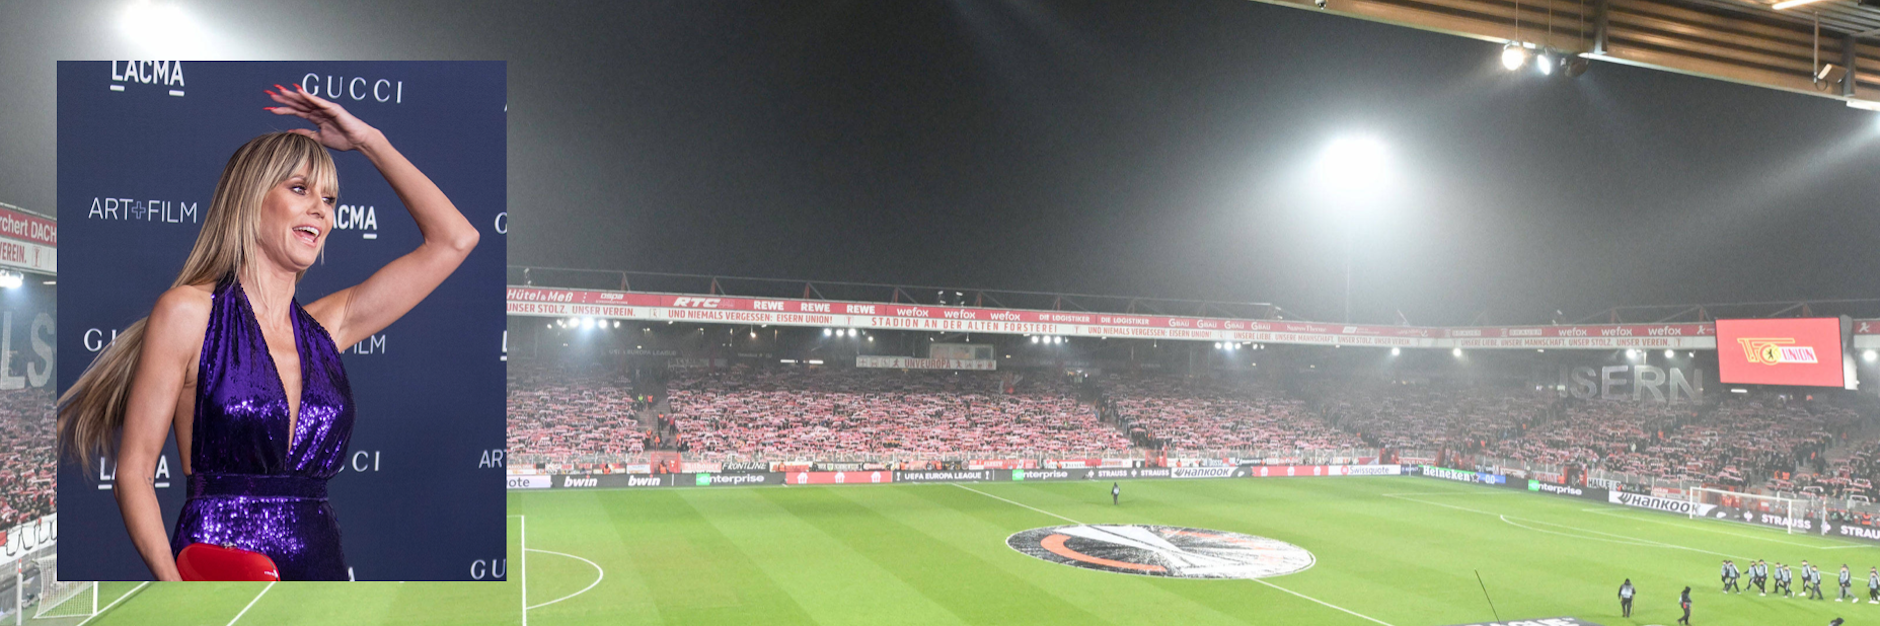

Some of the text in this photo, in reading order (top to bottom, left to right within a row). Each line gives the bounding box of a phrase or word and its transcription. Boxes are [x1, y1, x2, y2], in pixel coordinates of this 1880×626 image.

[111, 61, 185, 86] LACMA
[302, 73, 402, 103] GUCCI
[673, 297, 721, 308] RTC
[753, 301, 785, 311] REWE
[801, 302, 831, 312] REWE
[572, 305, 601, 315] UNSER
[846, 304, 876, 314] REWE
[897, 306, 929, 317] wefox
[944, 308, 976, 320] wefox
[668, 309, 833, 324] UND NIEMALS VERGESSEN: EISERN UNION!
[990, 310, 1021, 321] wefox
[872, 317, 919, 328] STADION
[924, 319, 938, 328] AN
[943, 320, 962, 329] DER
[967, 321, 999, 331] ALTEN
[1087, 326, 1102, 334] UND
[1103, 327, 1130, 335] NIEMALS
[1169, 329, 1190, 337] EISERN
[1191, 330, 1212, 338] UNION!
[1234, 331, 1255, 340] UNSERE
[1558, 327, 1587, 336] wefox
[1601, 326, 1633, 336] wefox
[1648, 325, 1681, 336] wefox
[1568, 339, 1590, 347] UNSER
[1616, 338, 1640, 346] UNSER
[1781, 348, 1815, 361] UNION
[1014, 470, 1068, 480] enterprise
[1098, 469, 1127, 477] STRAUSS
[1140, 469, 1169, 477] STRAUSS
[1350, 465, 1389, 475] Swissquote
[1423, 465, 1471, 482] Heineken
[564, 475, 598, 487] bwin
[628, 474, 661, 487] bwin
[698, 473, 765, 485] enterprise
[926, 472, 953, 480] EUROPA
[954, 472, 982, 480] LEAGUE
[1529, 482, 1582, 495] enterprise
